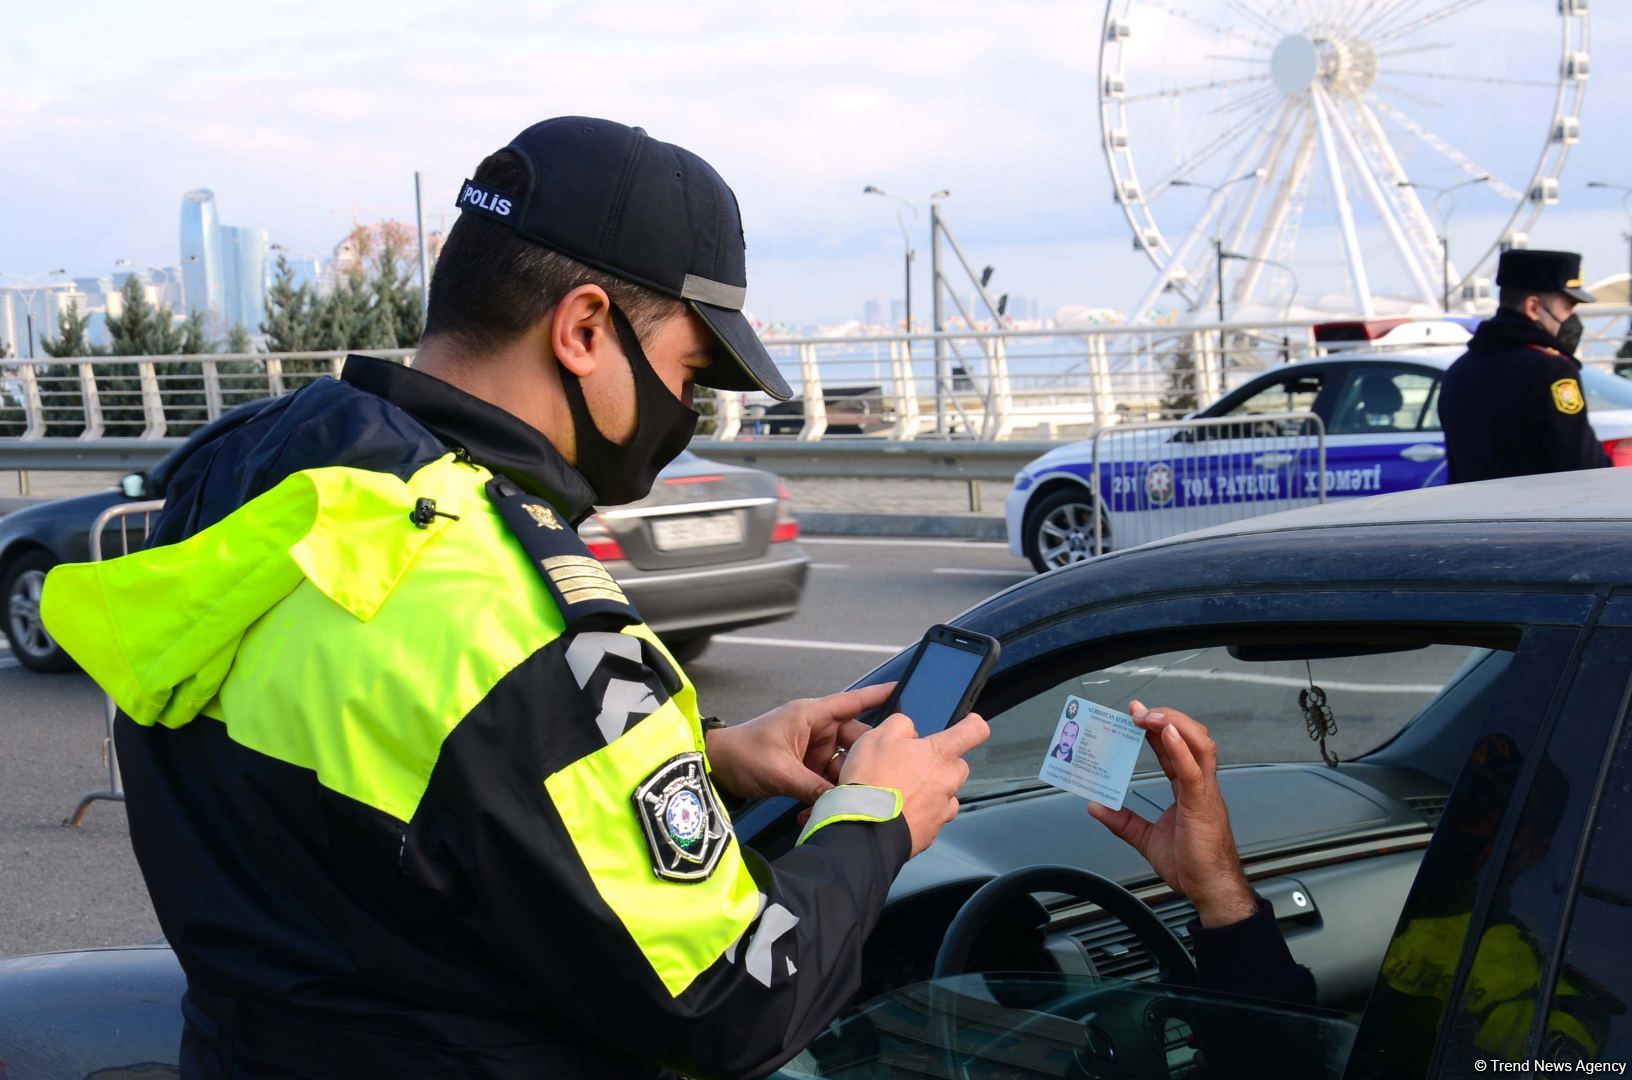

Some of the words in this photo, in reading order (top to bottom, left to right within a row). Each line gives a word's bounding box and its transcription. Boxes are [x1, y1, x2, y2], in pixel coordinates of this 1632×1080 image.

[463, 186, 512, 215] POLİS
[1181, 478, 1213, 498] YOL
[1304, 464, 1382, 492] XDMƏTİ
